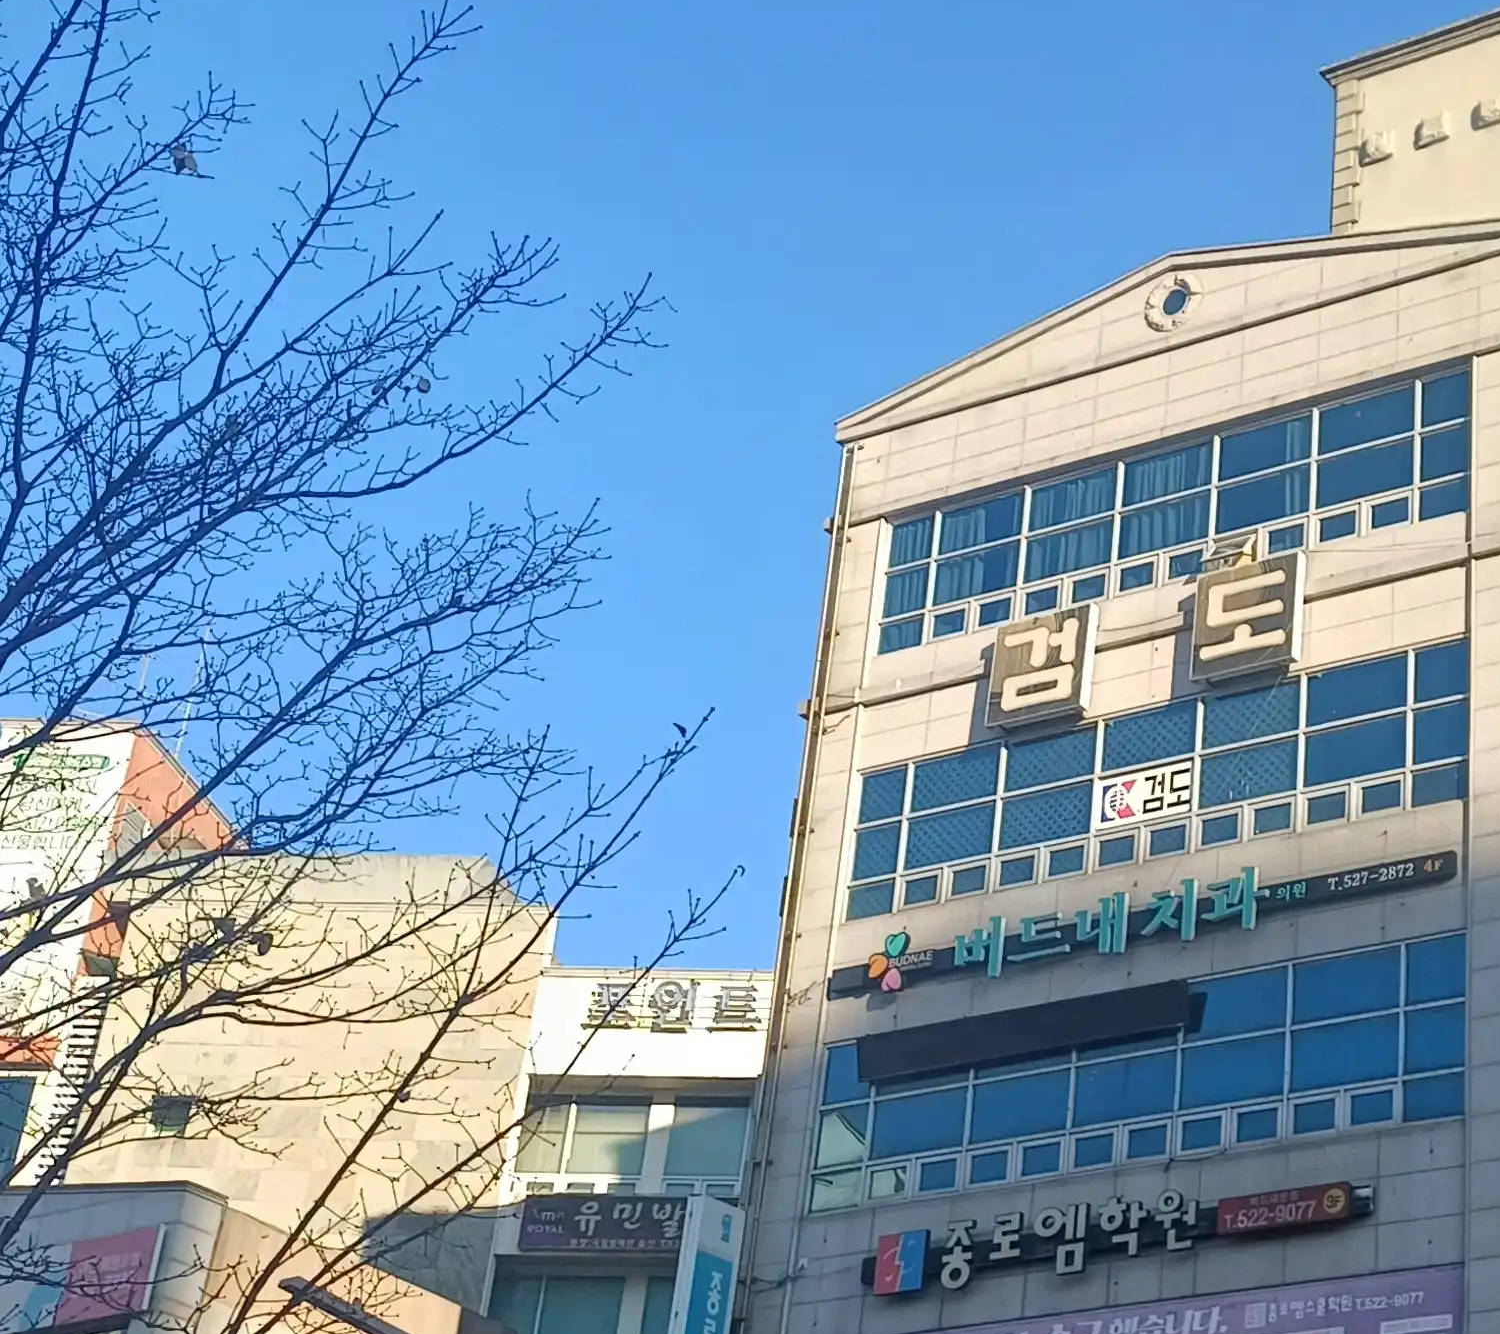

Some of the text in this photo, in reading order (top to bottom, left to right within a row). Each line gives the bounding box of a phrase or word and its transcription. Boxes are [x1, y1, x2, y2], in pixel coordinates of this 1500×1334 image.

[1143, 767, 1192, 815] 검도
[953, 865, 1271, 979] 버드내치과
[1224, 1200, 1318, 1230] T.522-9077
